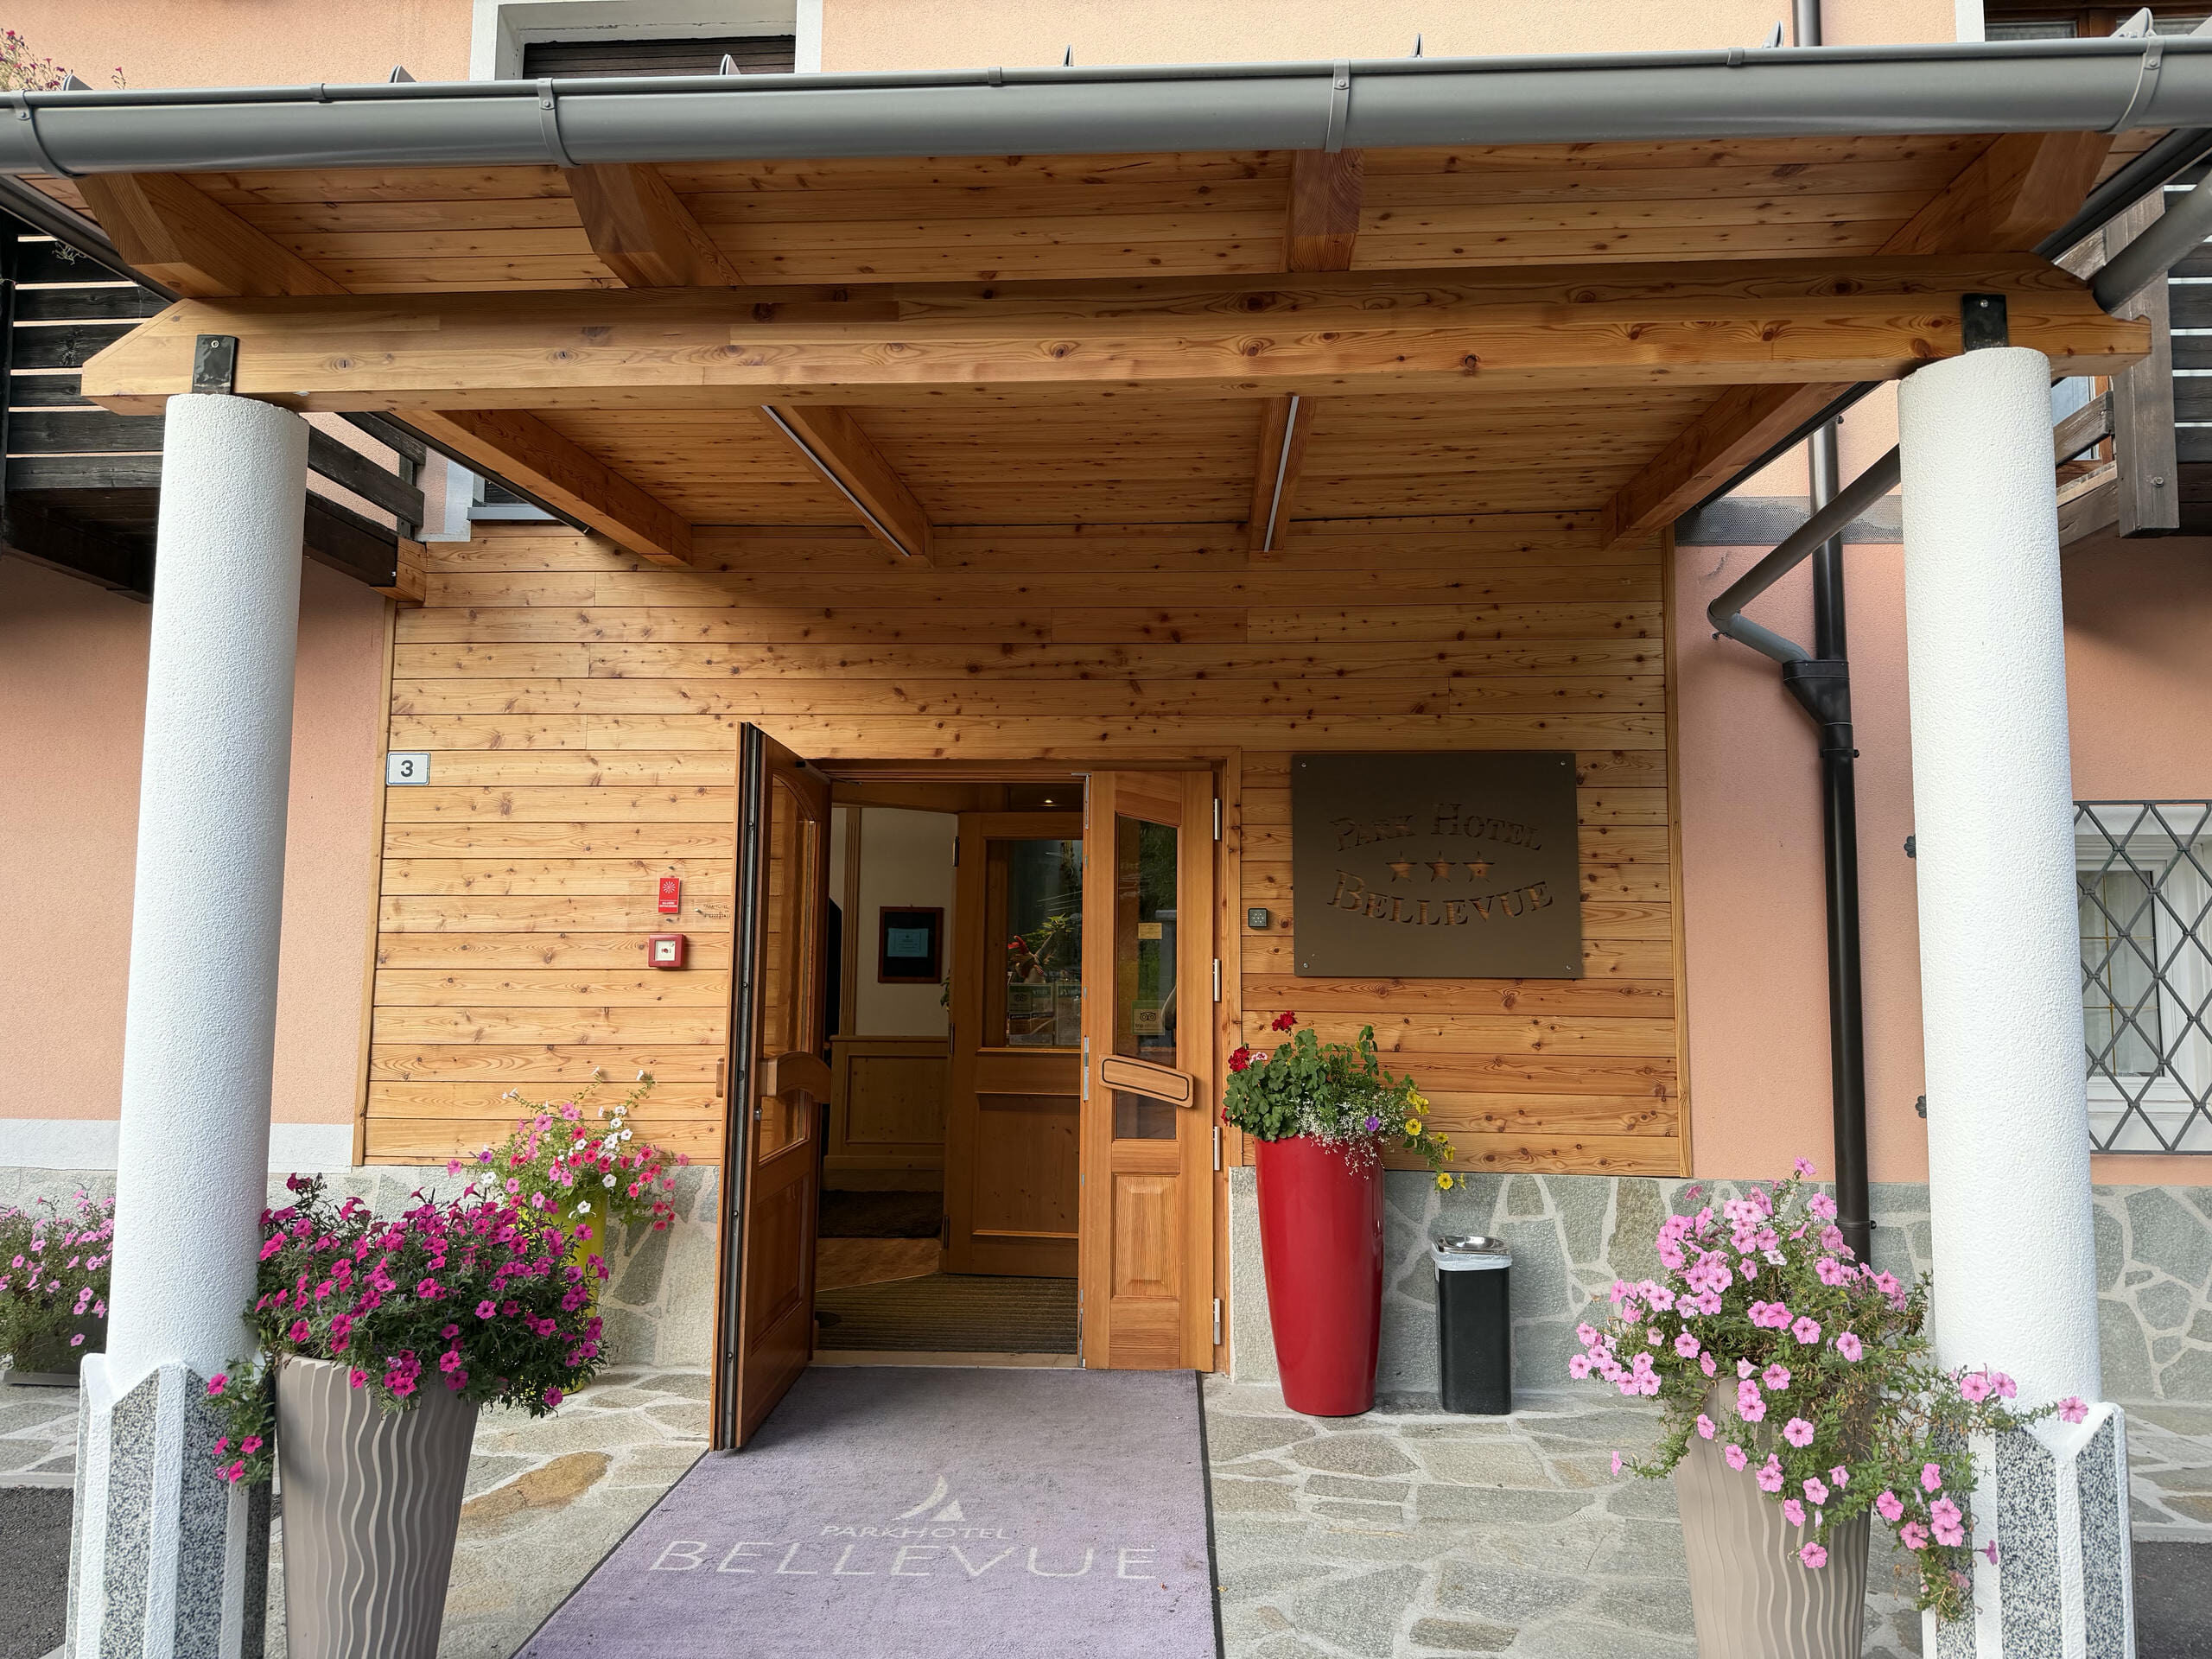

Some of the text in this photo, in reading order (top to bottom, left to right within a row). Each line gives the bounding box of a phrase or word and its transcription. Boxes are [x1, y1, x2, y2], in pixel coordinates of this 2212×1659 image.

[400, 760, 413, 778] 3
[1330, 803, 1542, 852] PARK HOTEL
[1327, 869, 1554, 926] BELLEVUE
[820, 1524, 1010, 1541] PARKHOTEL
[649, 1541, 1157, 1580] BELLEVUE
